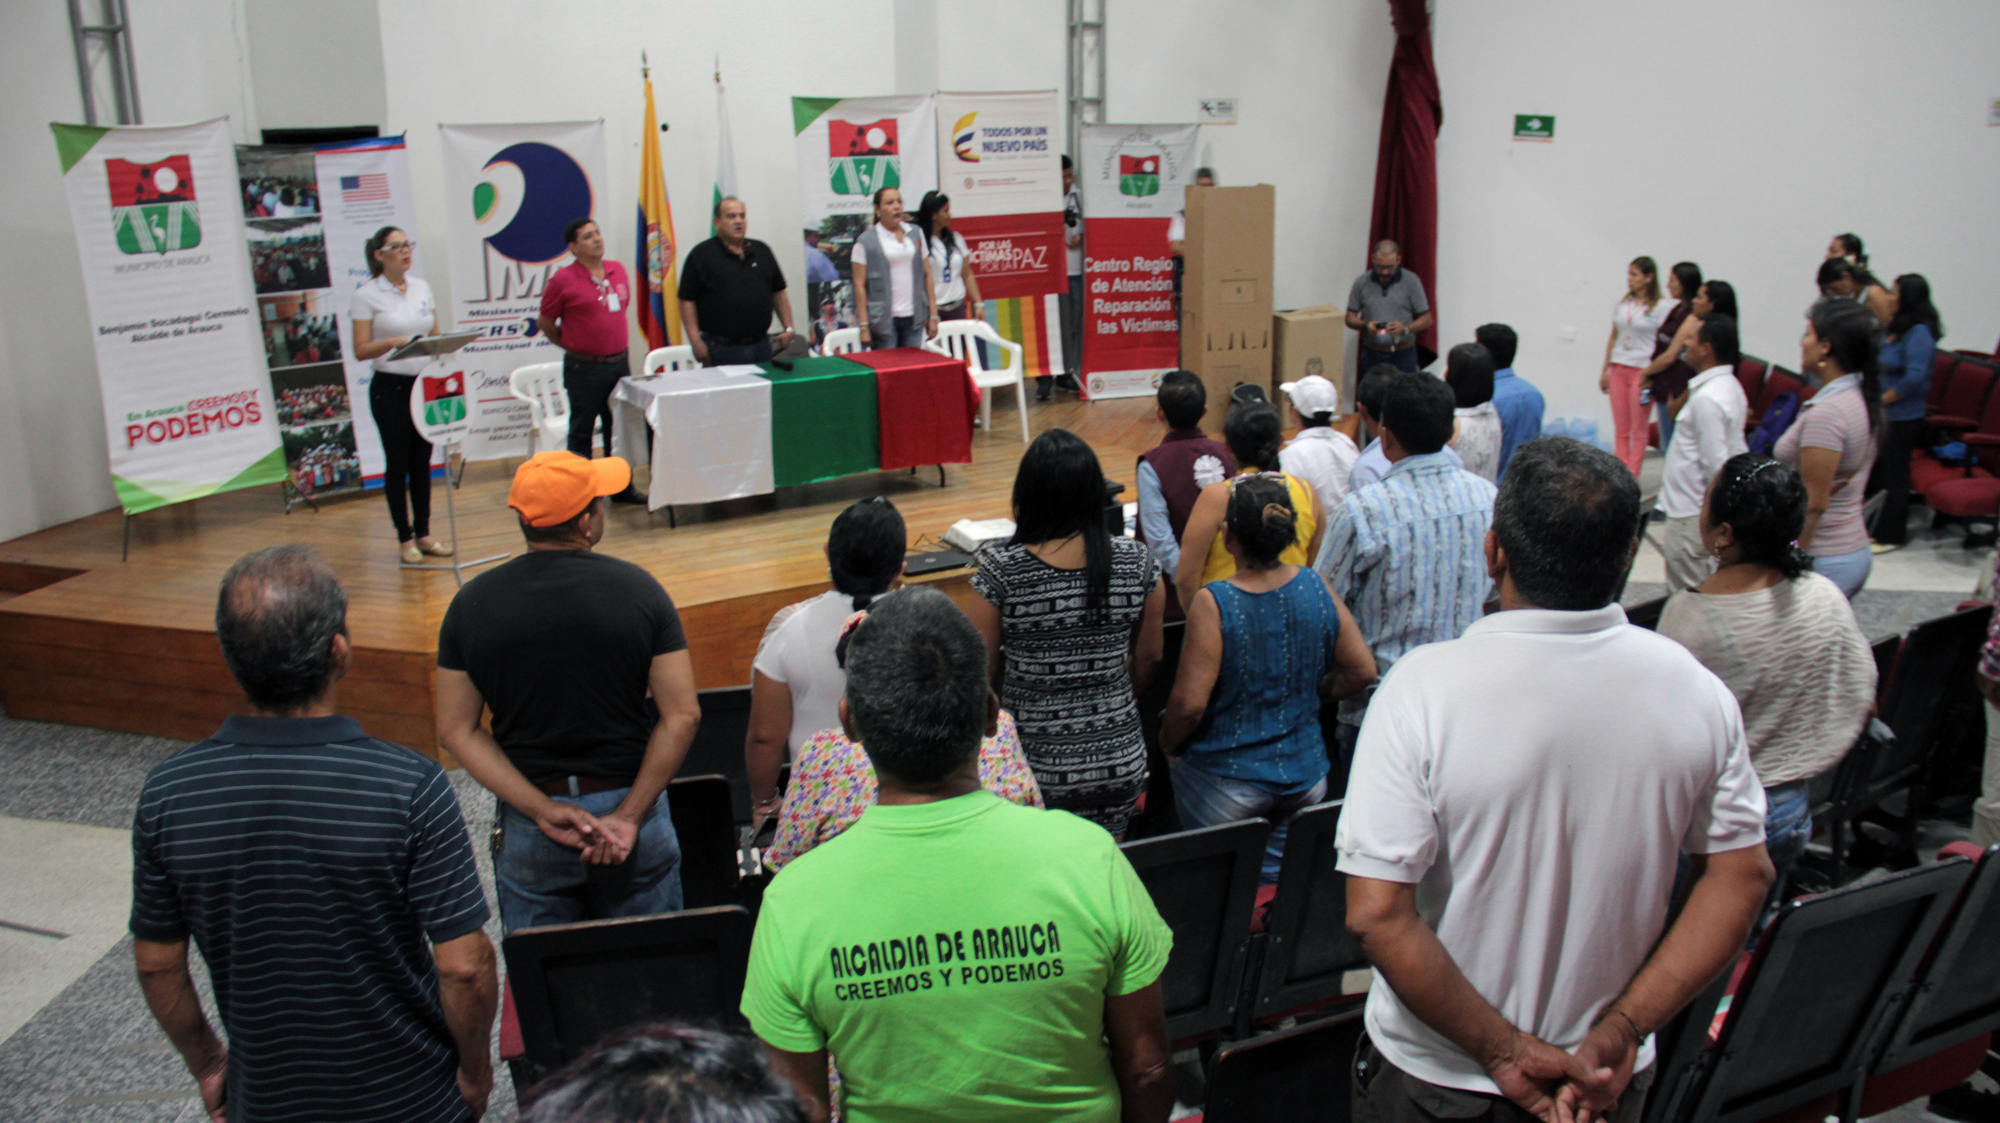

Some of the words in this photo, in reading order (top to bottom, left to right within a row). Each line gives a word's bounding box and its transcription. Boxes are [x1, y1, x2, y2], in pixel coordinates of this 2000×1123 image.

[981, 127, 1013, 137] TODOS
[1014, 126, 1033, 136] POR
[982, 140, 1021, 153] NUEVO
[1023, 137, 1048, 151] PAÍS
[978, 241, 996, 250] POR
[997, 239, 1012, 249] LAS
[114, 258, 162, 273] MUNICIPIO
[176, 254, 211, 267] ARAUCA
[969, 248, 1012, 264] ÍCTIMAS
[1012, 246, 1049, 270] PAZ
[1083, 257, 1130, 272] Centro
[1133, 256, 1174, 275] Regio
[1091, 278, 1109, 293] de
[1111, 277, 1173, 293] Atención
[1093, 297, 1171, 317] Reparación
[131, 330, 171, 344] Alcalde
[172, 327, 185, 337] de
[187, 323, 224, 335] Arauca
[1097, 319, 1118, 334] las
[1120, 317, 1179, 333] Víctimas
[127, 412, 143, 422] En
[144, 405, 185, 418] Arauca
[187, 390, 249, 411] CREEMOS
[126, 401, 262, 449] PODEMOS
[830, 934, 930, 978] ALCALDIA
[935, 930, 967, 963] DE
[972, 921, 1061, 960] ARAUCA
[835, 971, 933, 1001] CREEMOS
[939, 967, 953, 987] Y
[961, 958, 1064, 985] PODEMOS
